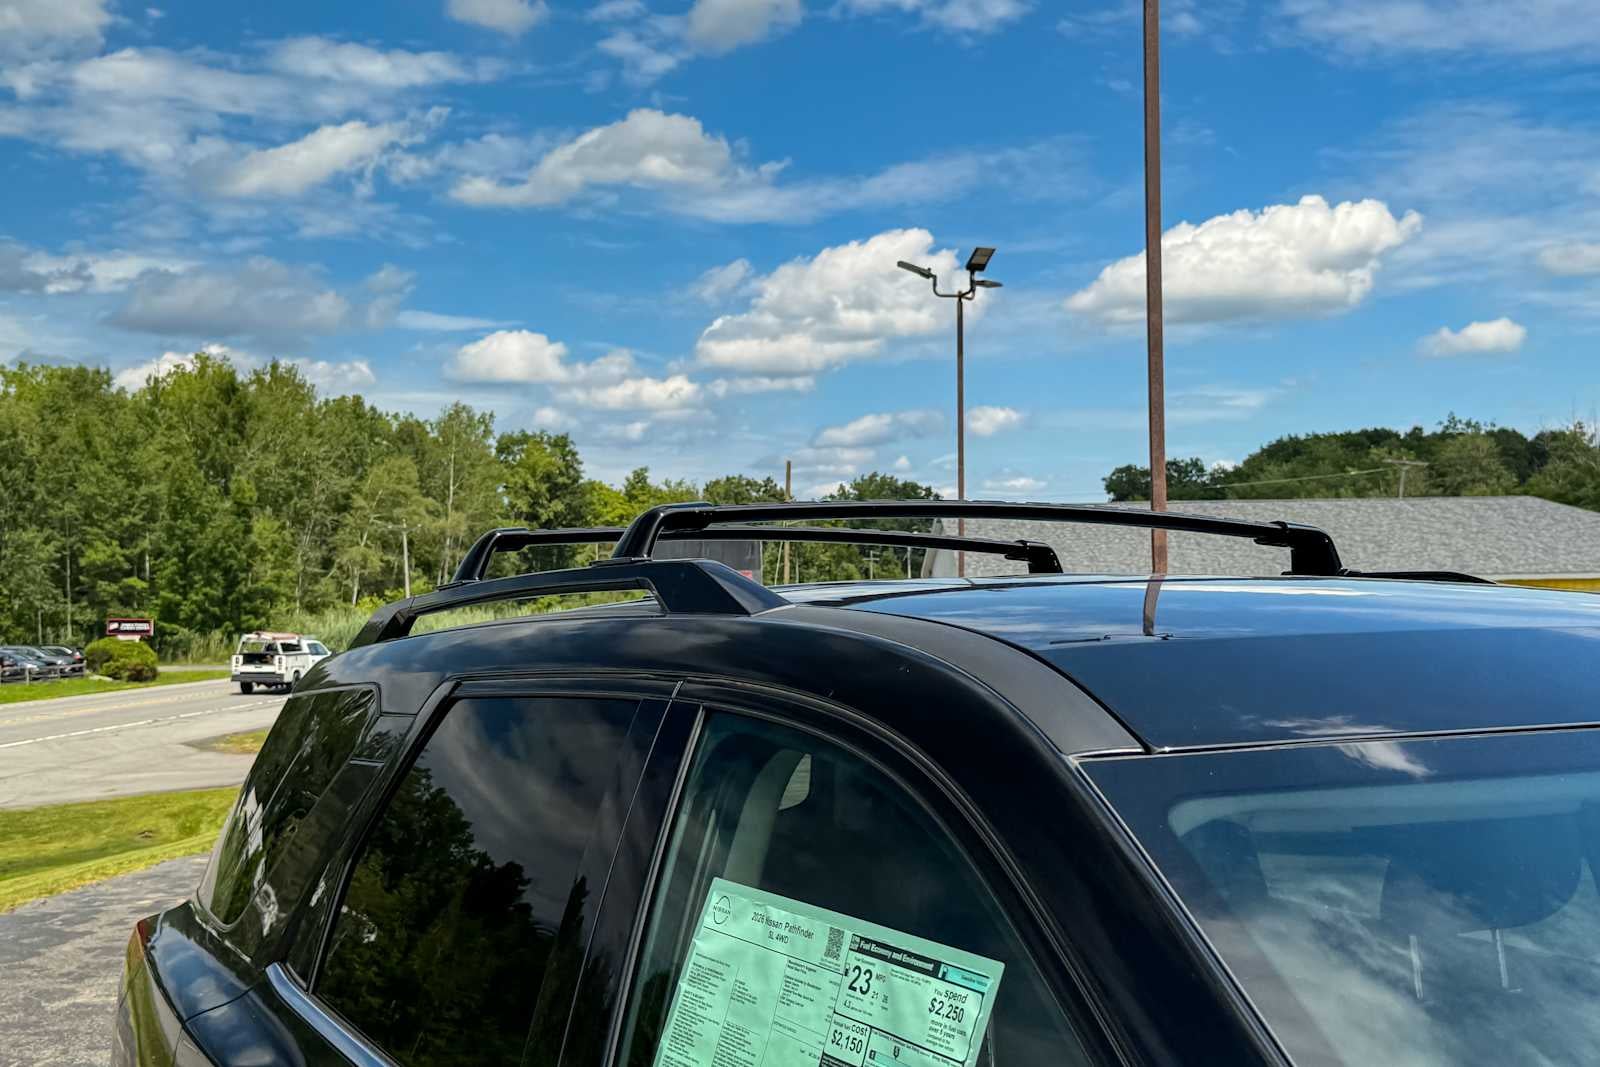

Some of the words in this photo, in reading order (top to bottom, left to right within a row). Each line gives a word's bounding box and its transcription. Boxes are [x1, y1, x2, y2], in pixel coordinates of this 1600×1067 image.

[713, 904, 731, 915] NISSAN
[751, 911, 765, 924] 2026
[765, 914, 783, 930] Nissan
[784, 921, 814, 940] Pathfinder
[768, 930, 775, 940] SL
[776, 933, 789, 944] 4WD
[860, 940, 871, 950] Fuel
[848, 965, 873, 995] 23
[934, 988, 944, 997] You
[944, 989, 969, 1004] spend
[928, 997, 965, 1023] $2,250
[851, 1024, 868, 1037] cost
[831, 1029, 863, 1054] $2,150
